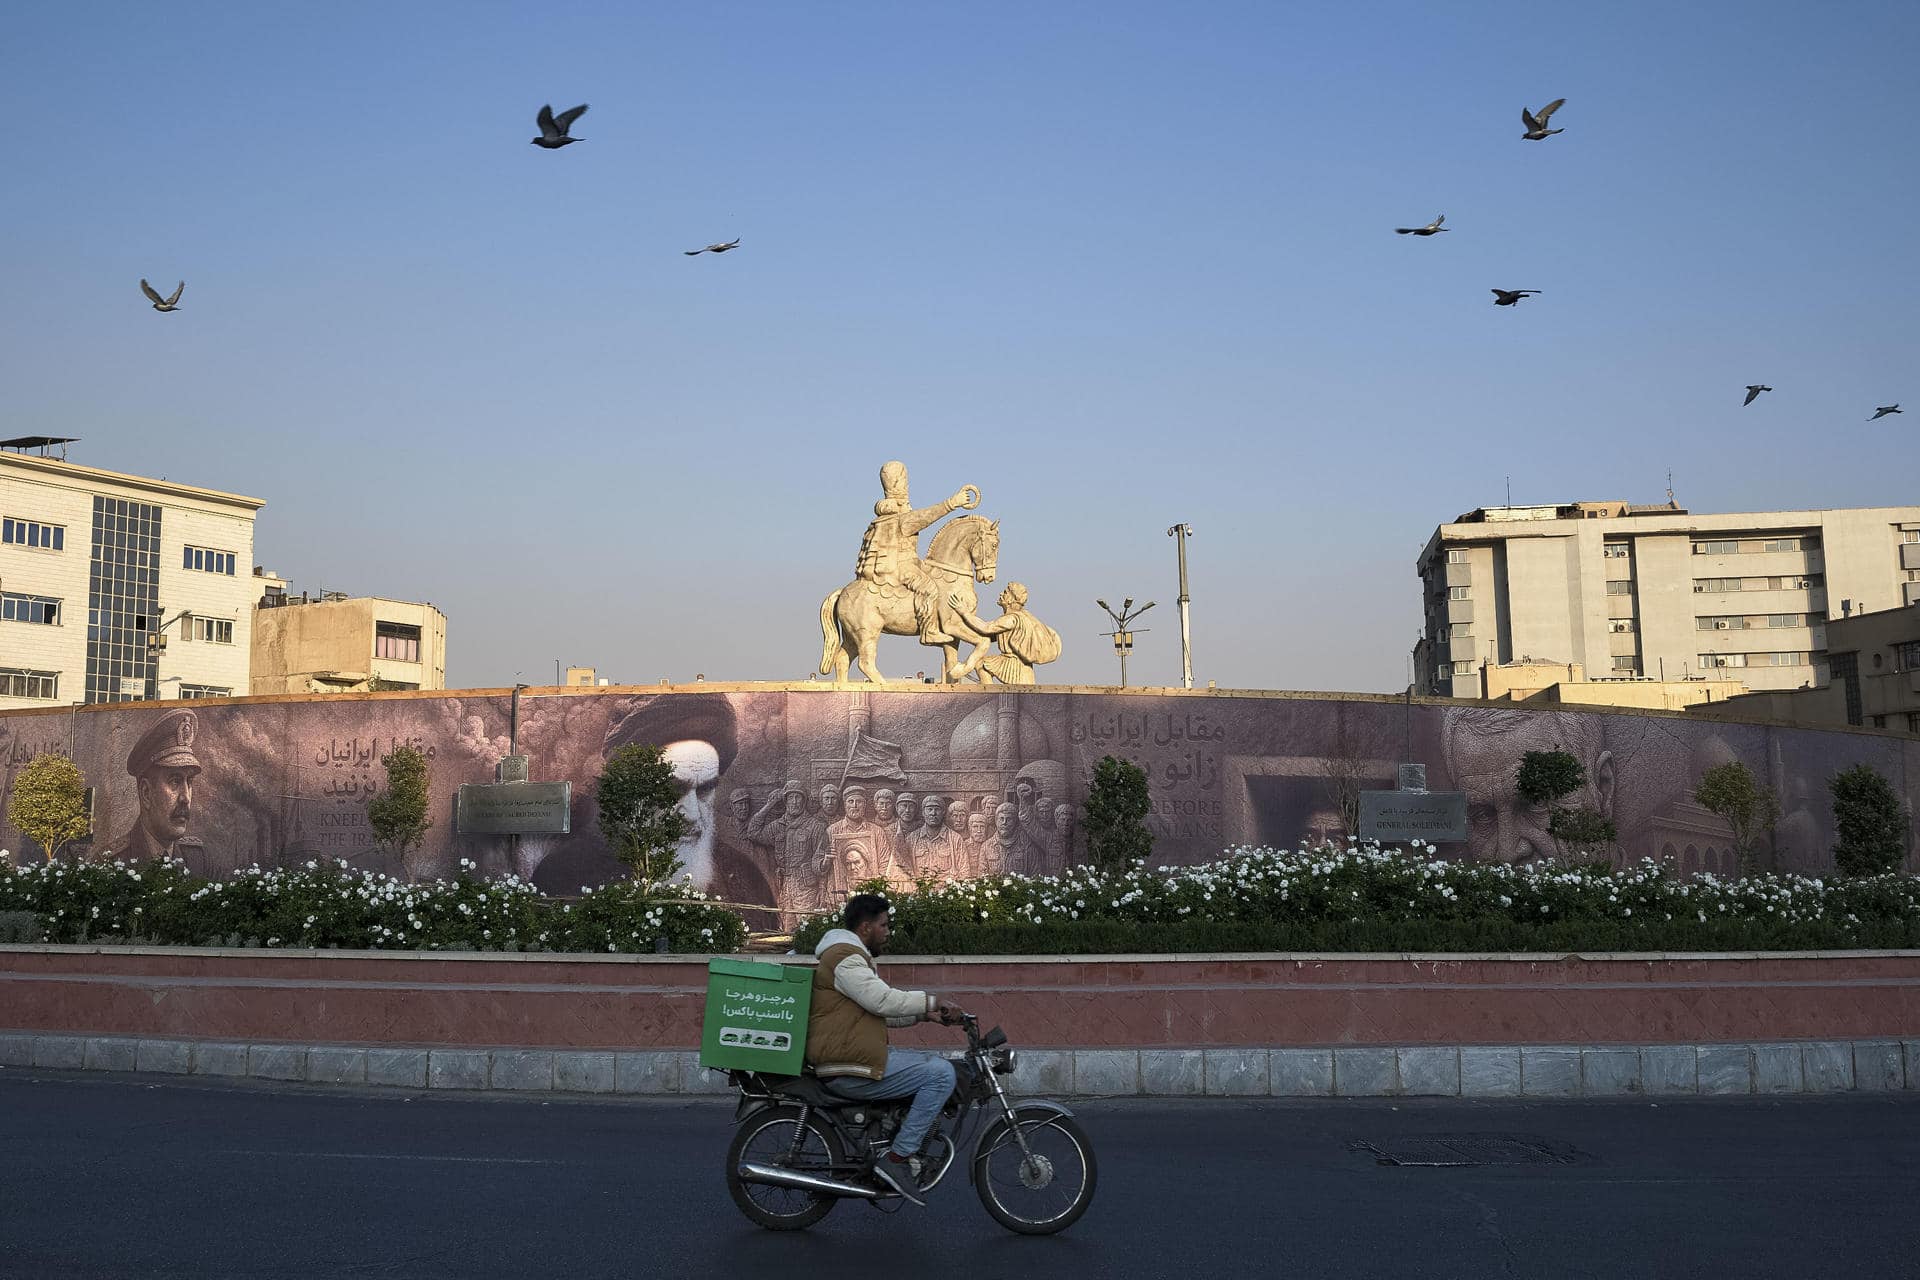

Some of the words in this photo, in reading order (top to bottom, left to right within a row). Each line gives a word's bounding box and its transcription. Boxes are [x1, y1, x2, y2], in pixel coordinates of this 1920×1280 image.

[1069, 713, 1148, 749] ایرانیان
[1154, 713, 1225, 748] مقابل
[315, 737, 377, 769] ایرانیان
[1162, 750, 1217, 791] زانو
[1149, 799, 1222, 815] BEFORE
[320, 813, 367, 827] KNEEL
[318, 832, 346, 847] THE
[726, 989, 741, 1000] جا
[740, 992, 754, 1001] هر
[760, 993, 781, 1006] چیز
[781, 996, 795, 1005] هر
[755, 1010, 784, 1023] اسنپ
[785, 1010, 794, 1023] با
